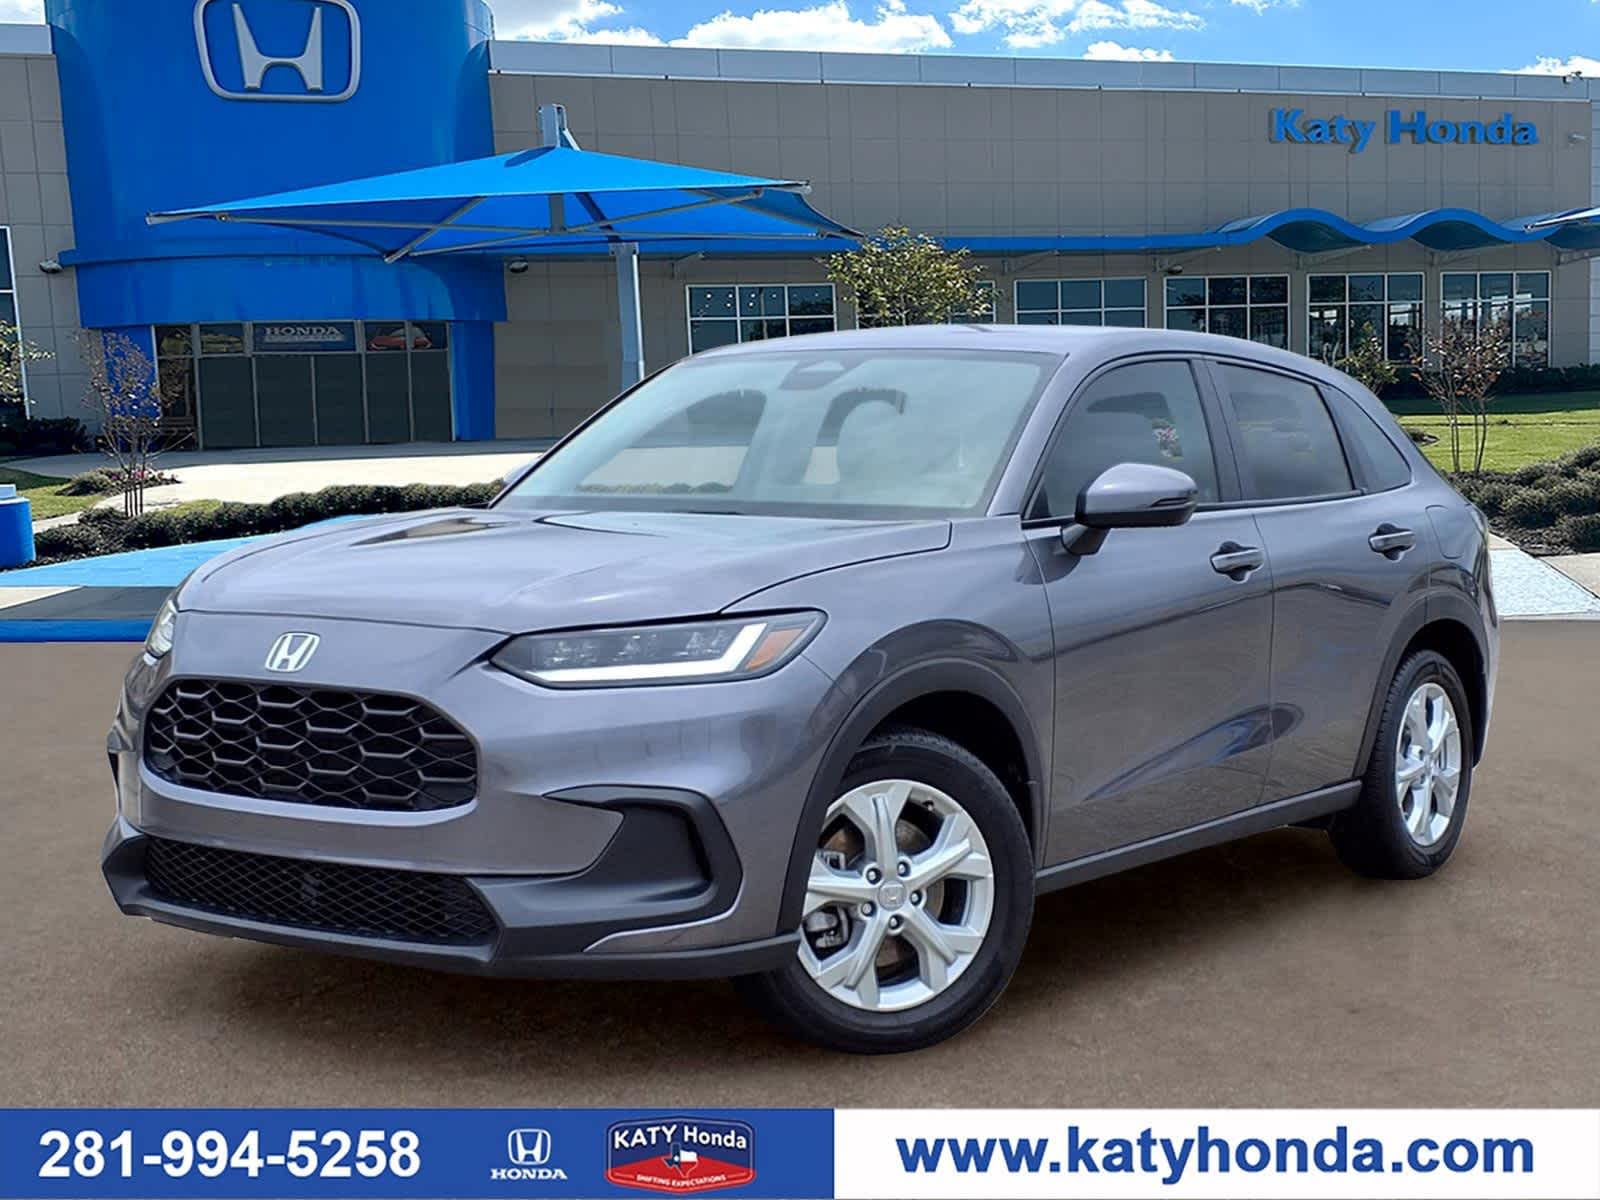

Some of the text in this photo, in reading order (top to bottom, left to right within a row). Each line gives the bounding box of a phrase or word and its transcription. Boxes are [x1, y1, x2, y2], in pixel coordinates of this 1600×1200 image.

[1269, 107, 1539, 153] Katy Honda
[264, 326, 341, 337] HONDA
